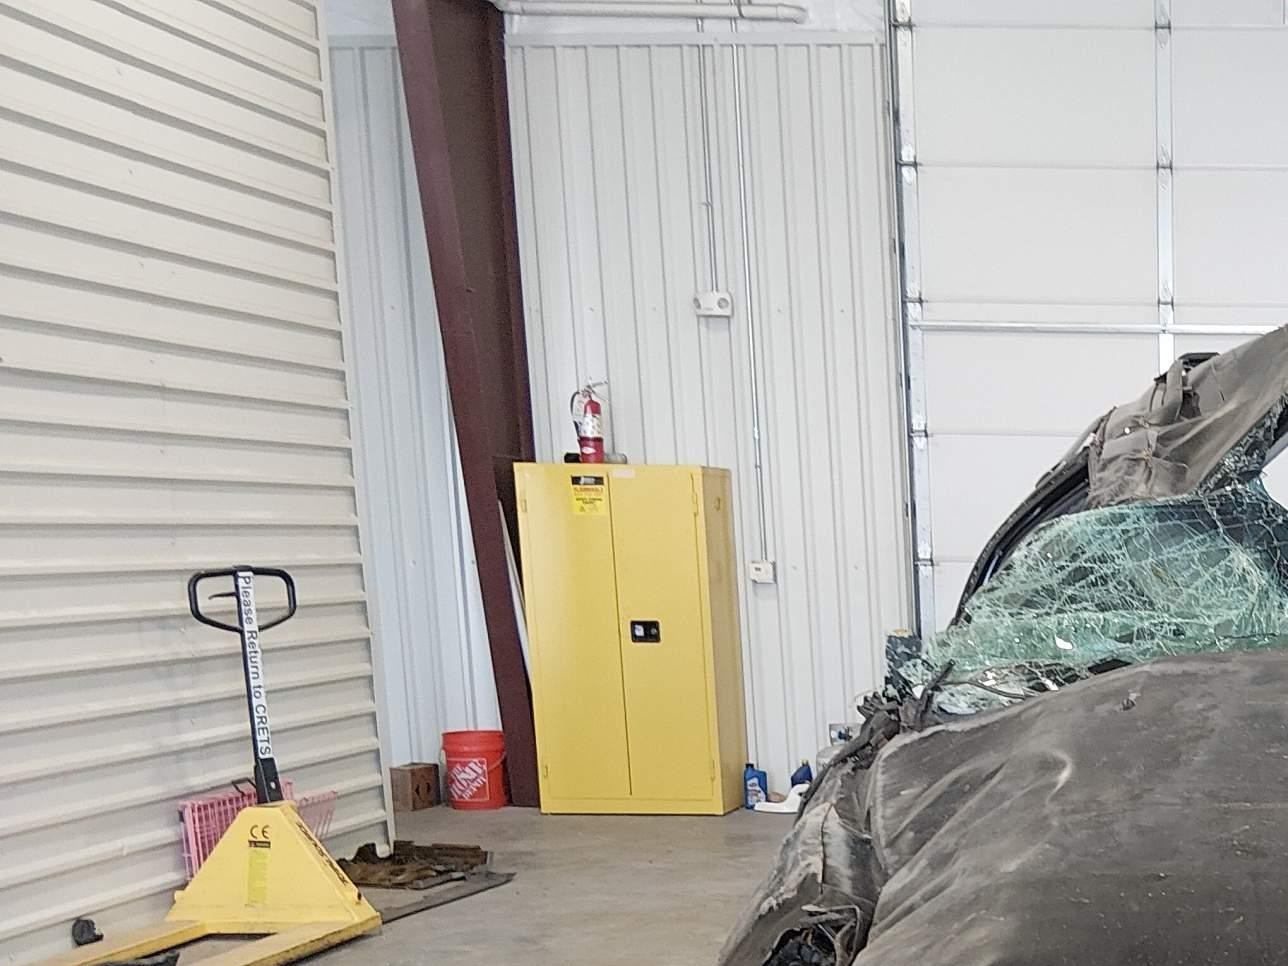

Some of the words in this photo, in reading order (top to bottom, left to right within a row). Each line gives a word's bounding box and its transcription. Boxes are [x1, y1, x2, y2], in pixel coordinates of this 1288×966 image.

[239, 574, 254, 625] Please
[247, 629, 260, 680] Return
[253, 683, 263, 700] to
[255, 703, 272, 756] CRETS
[249, 824, 271, 839] CE
